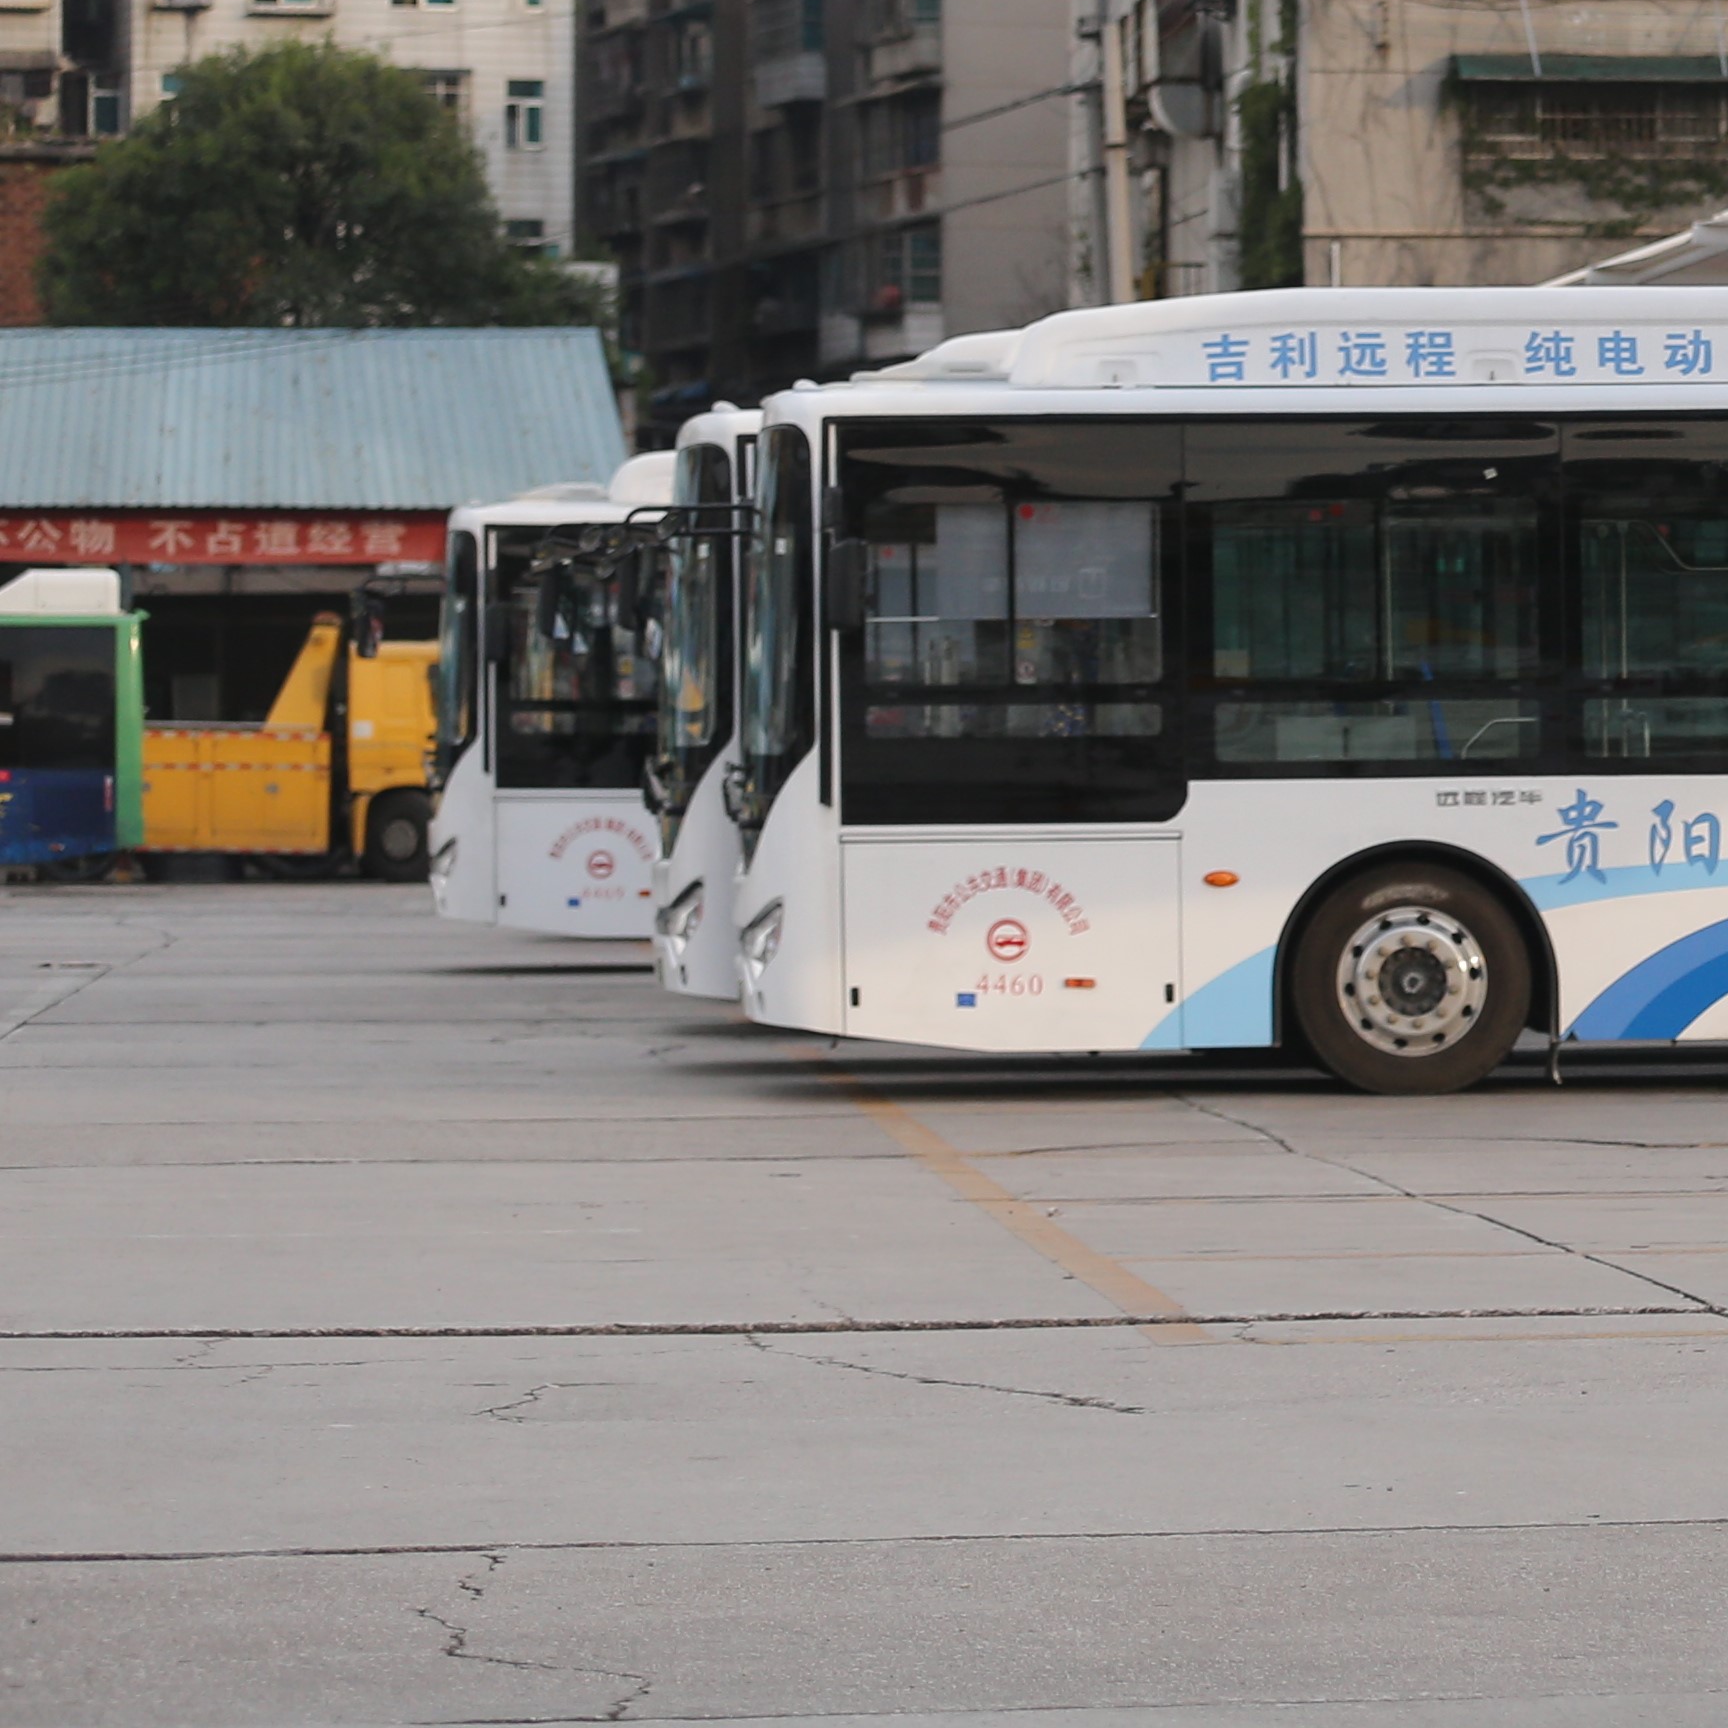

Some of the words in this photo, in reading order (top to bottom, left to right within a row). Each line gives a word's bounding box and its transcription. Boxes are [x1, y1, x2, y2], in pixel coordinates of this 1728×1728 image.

[1204, 330, 1457, 382] 吉利远程
[149, 520, 408, 556] 不占道经营
[976, 973, 1044, 996] 4460
